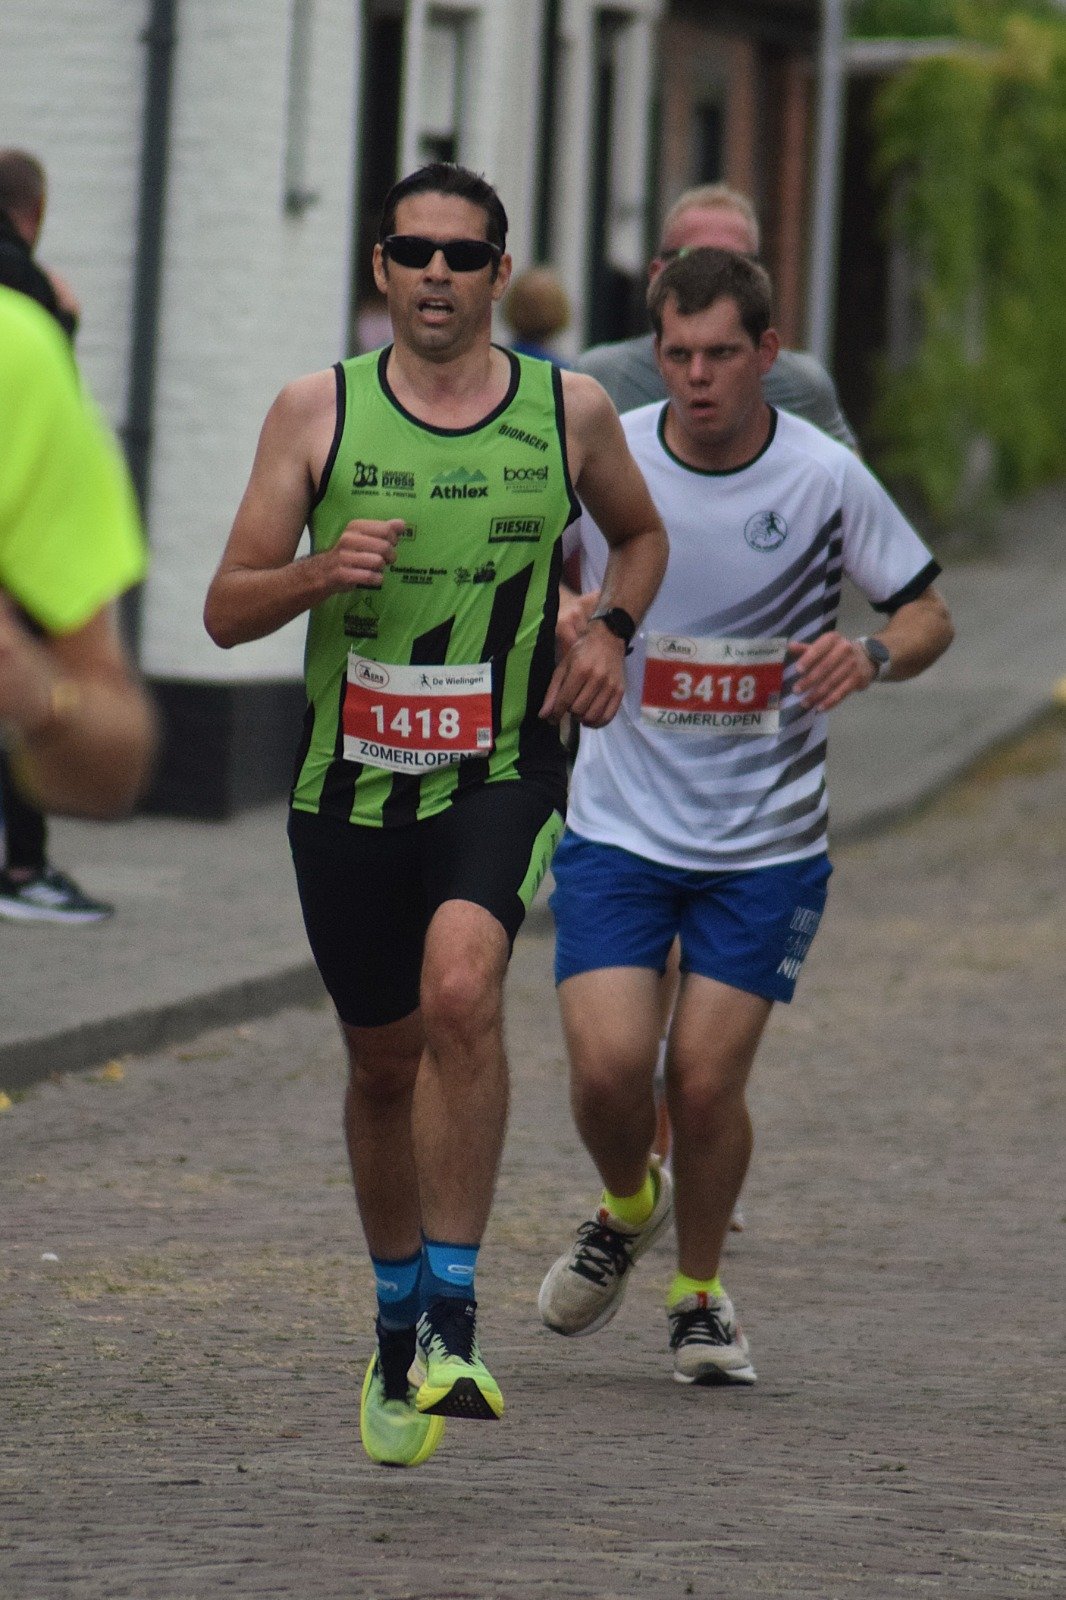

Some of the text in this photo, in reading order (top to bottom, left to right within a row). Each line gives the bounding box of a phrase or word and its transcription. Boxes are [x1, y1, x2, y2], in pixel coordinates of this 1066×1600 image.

[499, 424, 549, 452] BIORACER
[382, 476, 415, 488] press
[430, 484, 488, 499] Athlex
[432, 676, 484, 686] De Wielingen
[671, 671, 756, 704] 3418
[370, 704, 460, 739] 1418
[657, 711, 762, 727] ZOMERLOPEN
